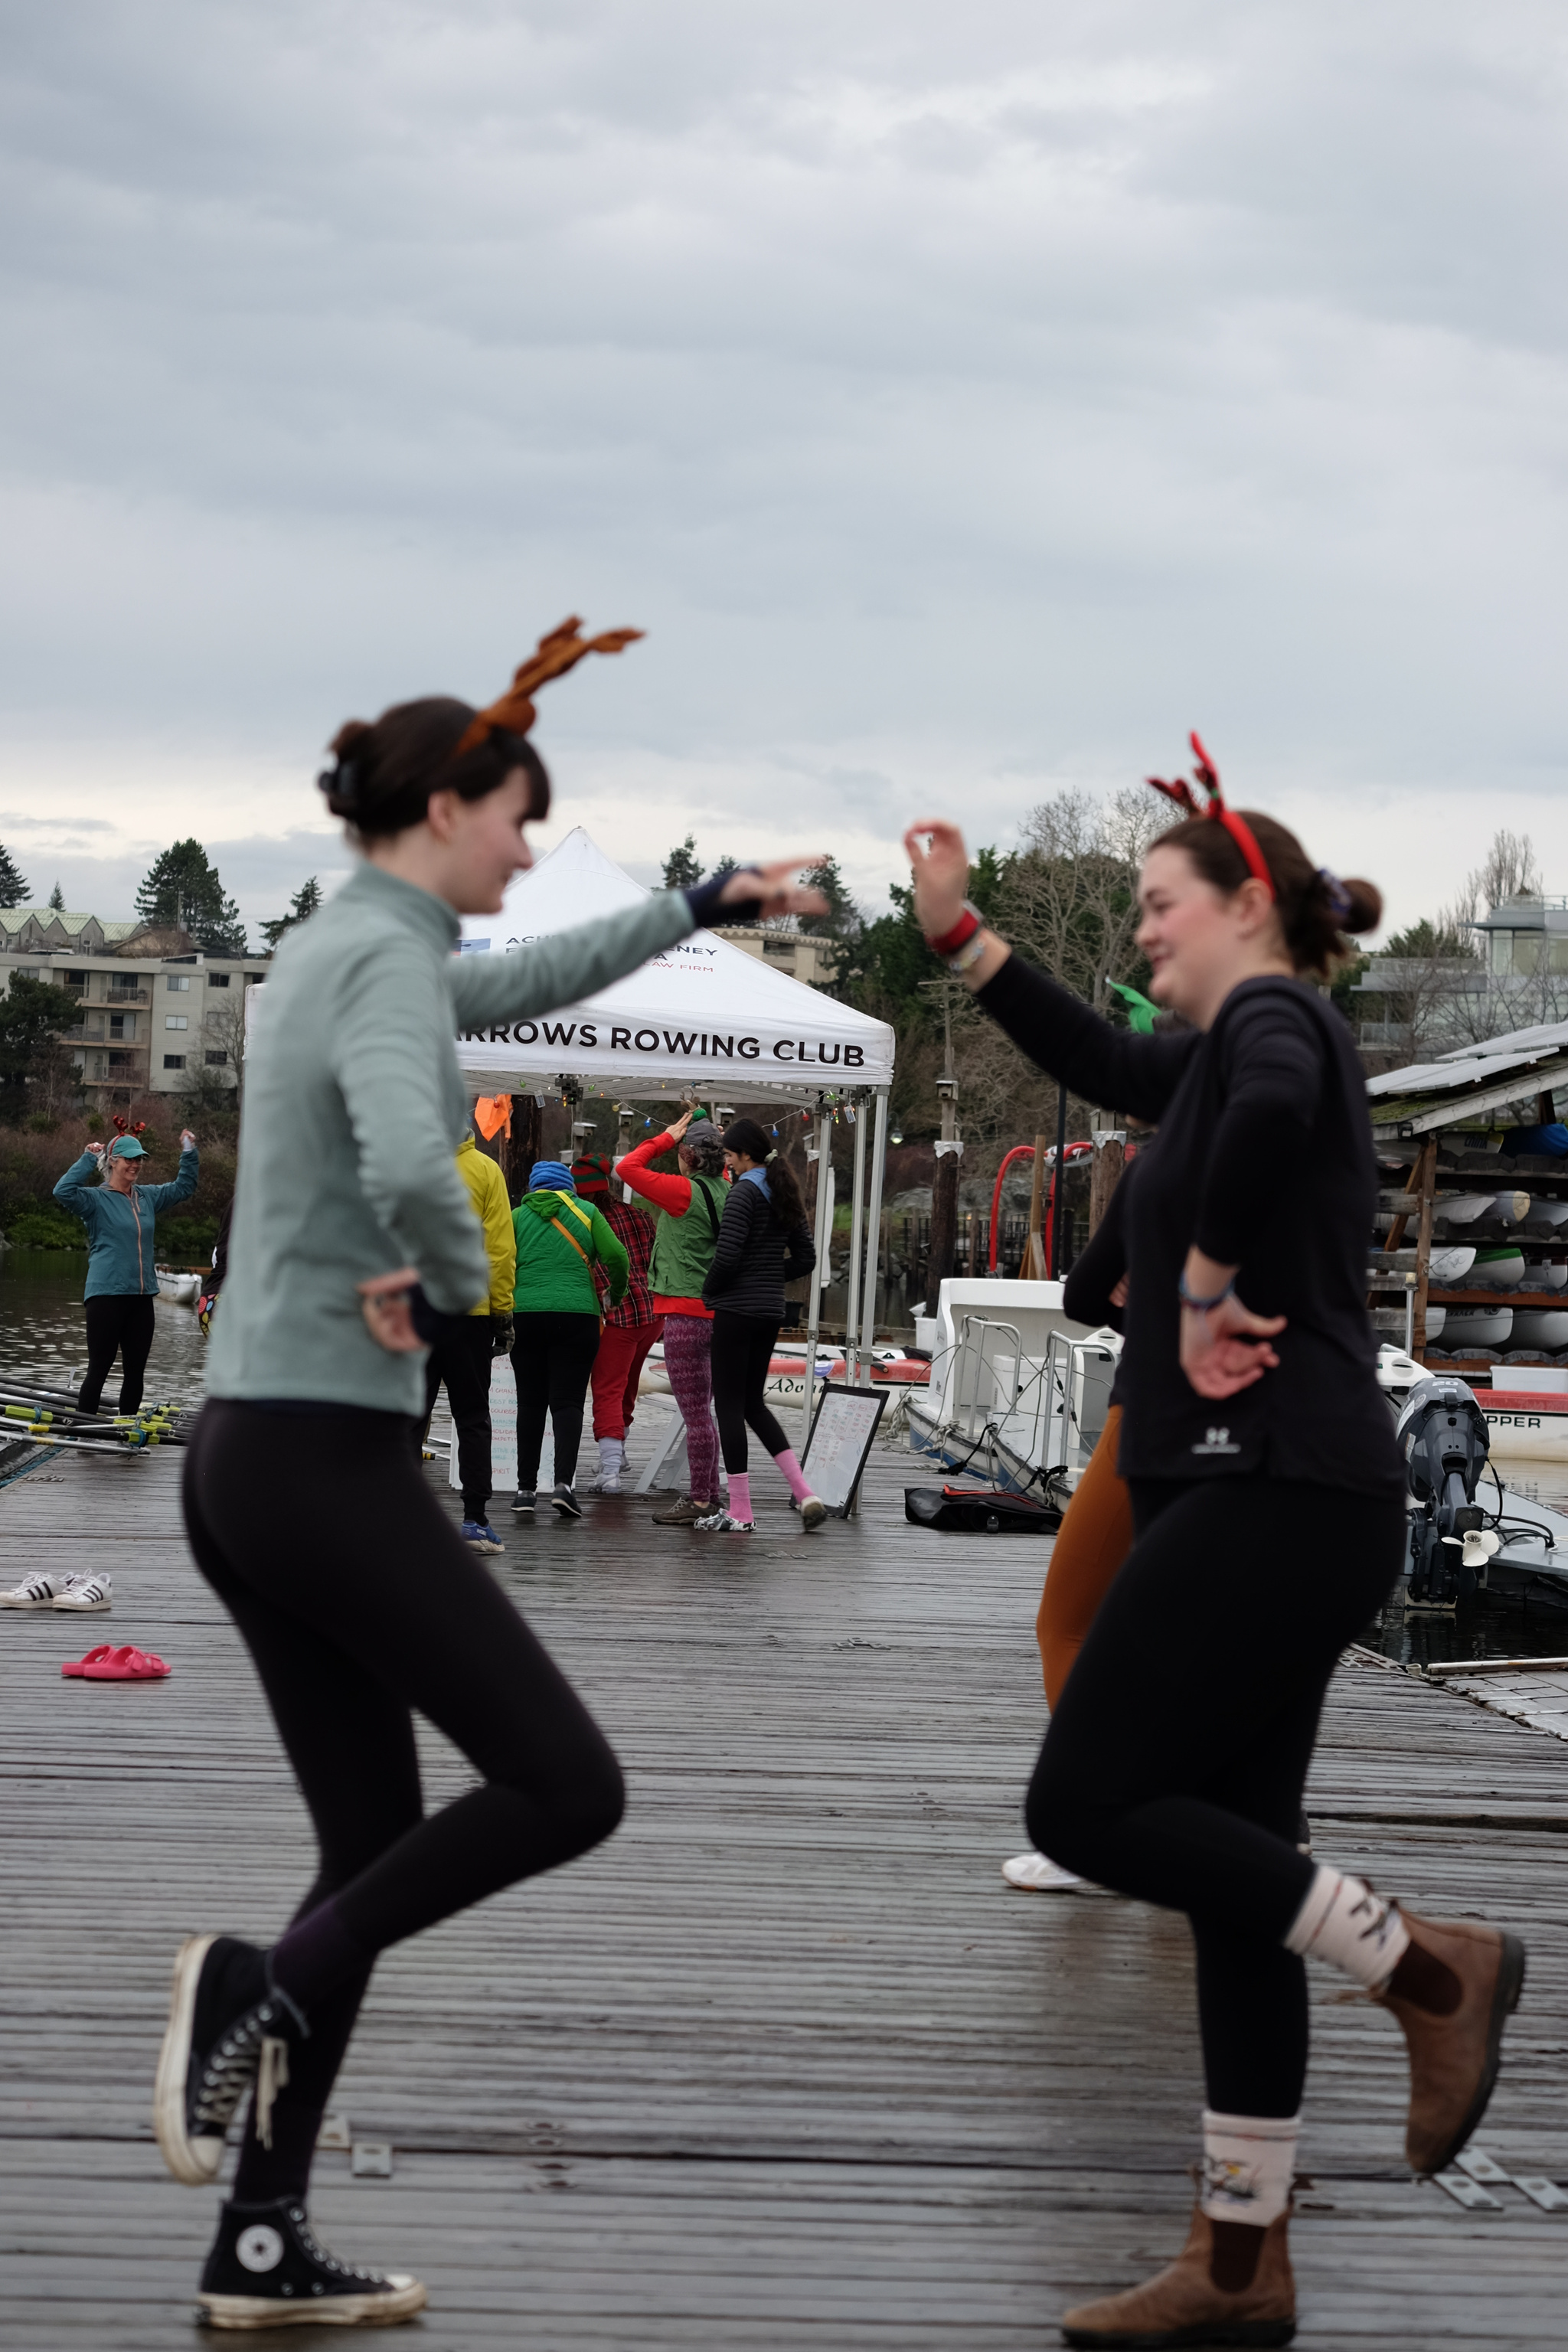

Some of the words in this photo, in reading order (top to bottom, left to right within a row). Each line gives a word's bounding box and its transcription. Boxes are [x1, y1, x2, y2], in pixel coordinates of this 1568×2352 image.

[611, 1027, 760, 1059] ROWING
[773, 1040, 864, 1067] CLUB
[1486, 1415, 1540, 1429] PPER
